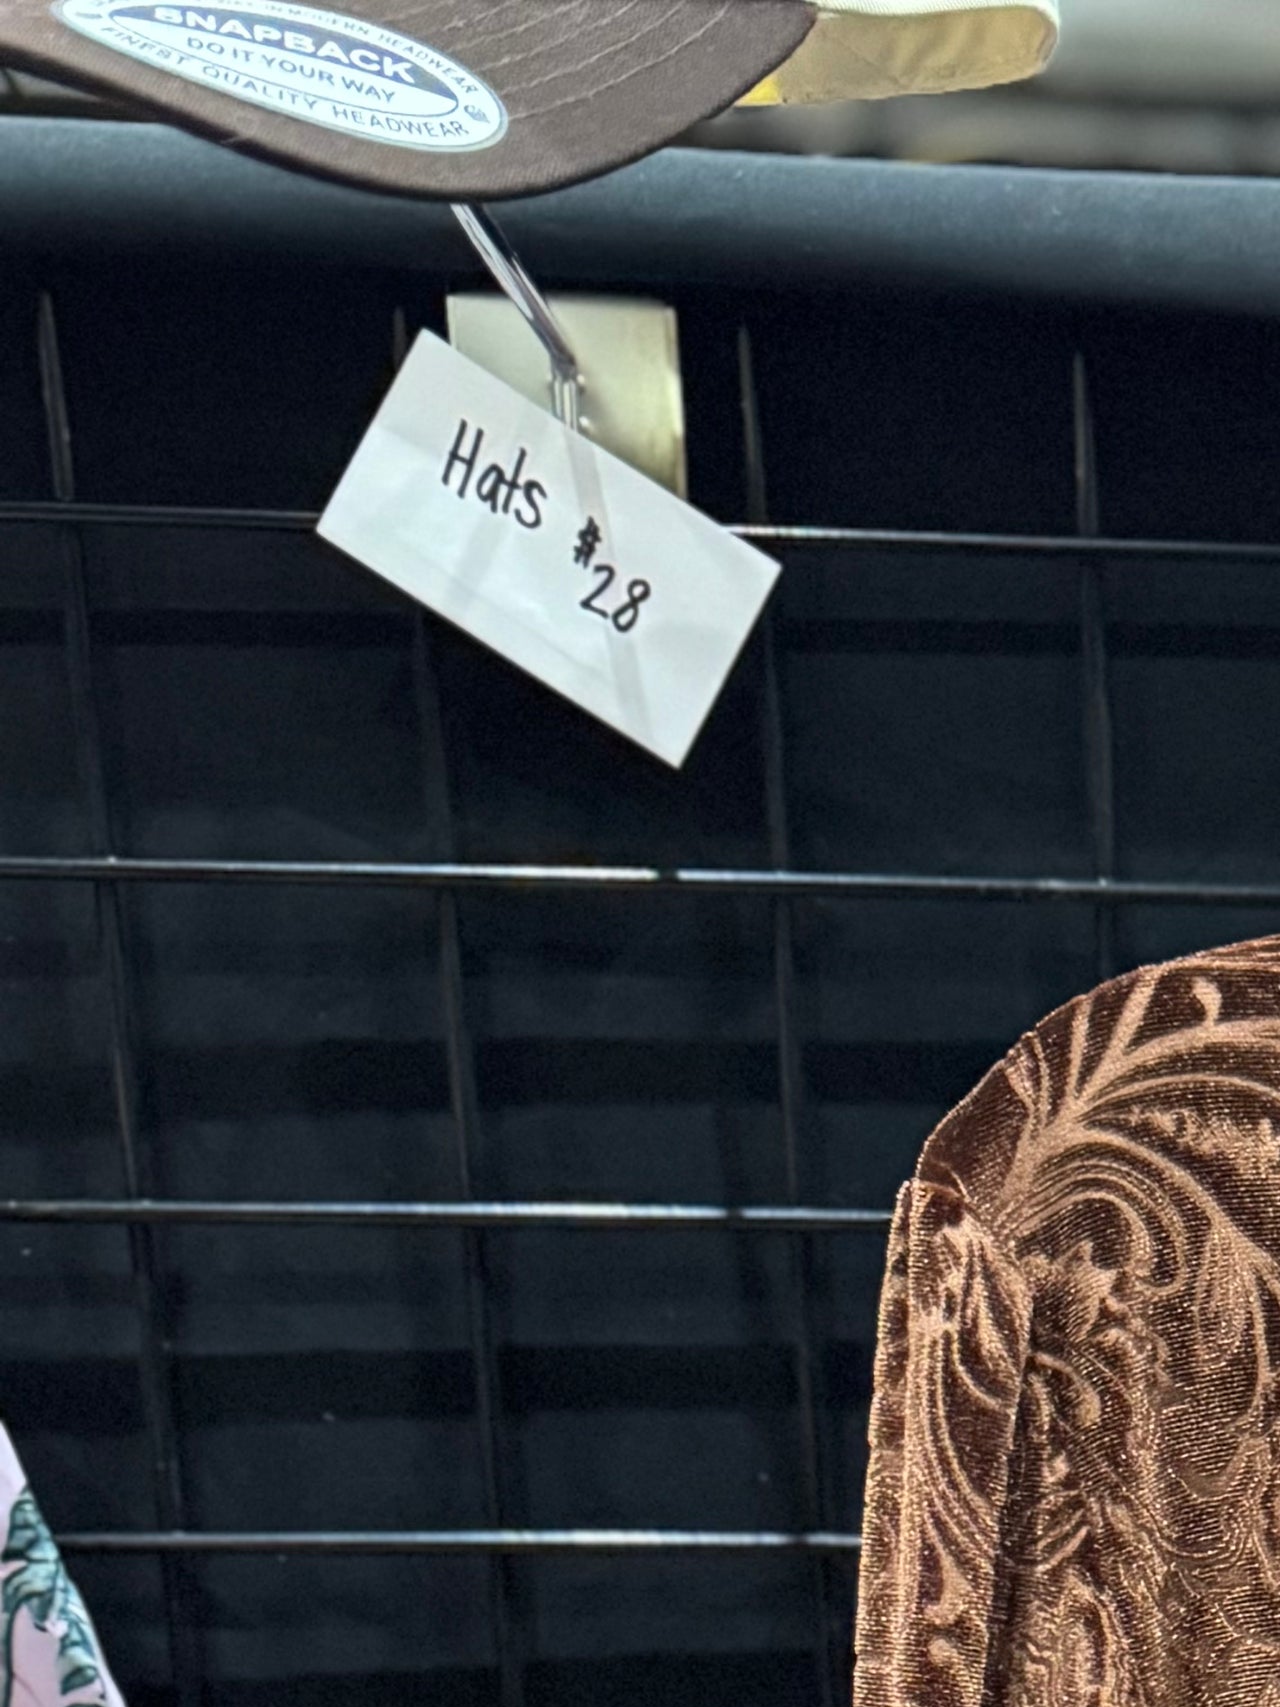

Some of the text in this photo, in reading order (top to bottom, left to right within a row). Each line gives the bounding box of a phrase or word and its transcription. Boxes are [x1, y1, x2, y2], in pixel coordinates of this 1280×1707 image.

[101, 27, 470, 138] FINEST QUALITY HEADWEAR
[153, 6, 416, 84] SNAPBACK
[187, 37, 396, 104] DO IT YOUR WAY
[378, 33, 480, 94] HEADWEAR
[441, 418, 548, 529] Hats
